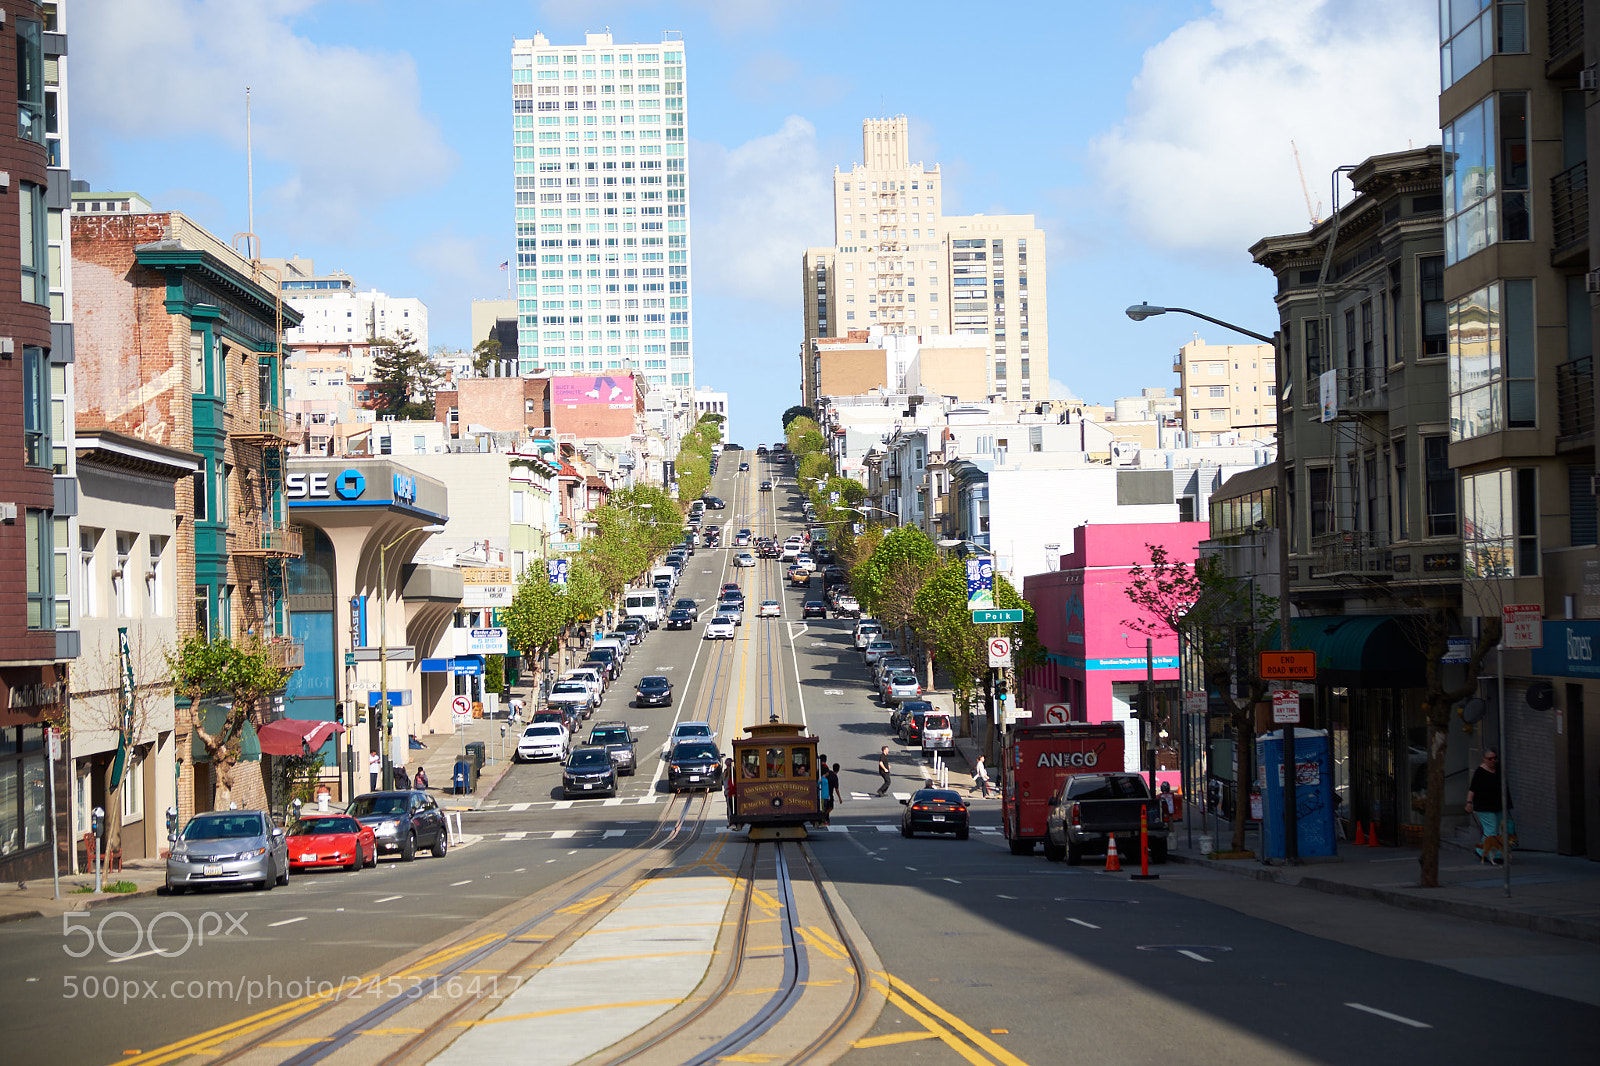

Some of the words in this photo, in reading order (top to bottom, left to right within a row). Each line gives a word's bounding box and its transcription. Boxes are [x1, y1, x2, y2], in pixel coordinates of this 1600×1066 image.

[1505, 613, 1515, 623] NO
[1516, 613, 1540, 622] STOPPING
[1514, 632, 1533, 640] TIME
[1281, 656, 1295, 664] END
[1267, 666, 1286, 674] ROAD
[1289, 666, 1309, 674] WORK
[8, 684, 34, 709] Audio
